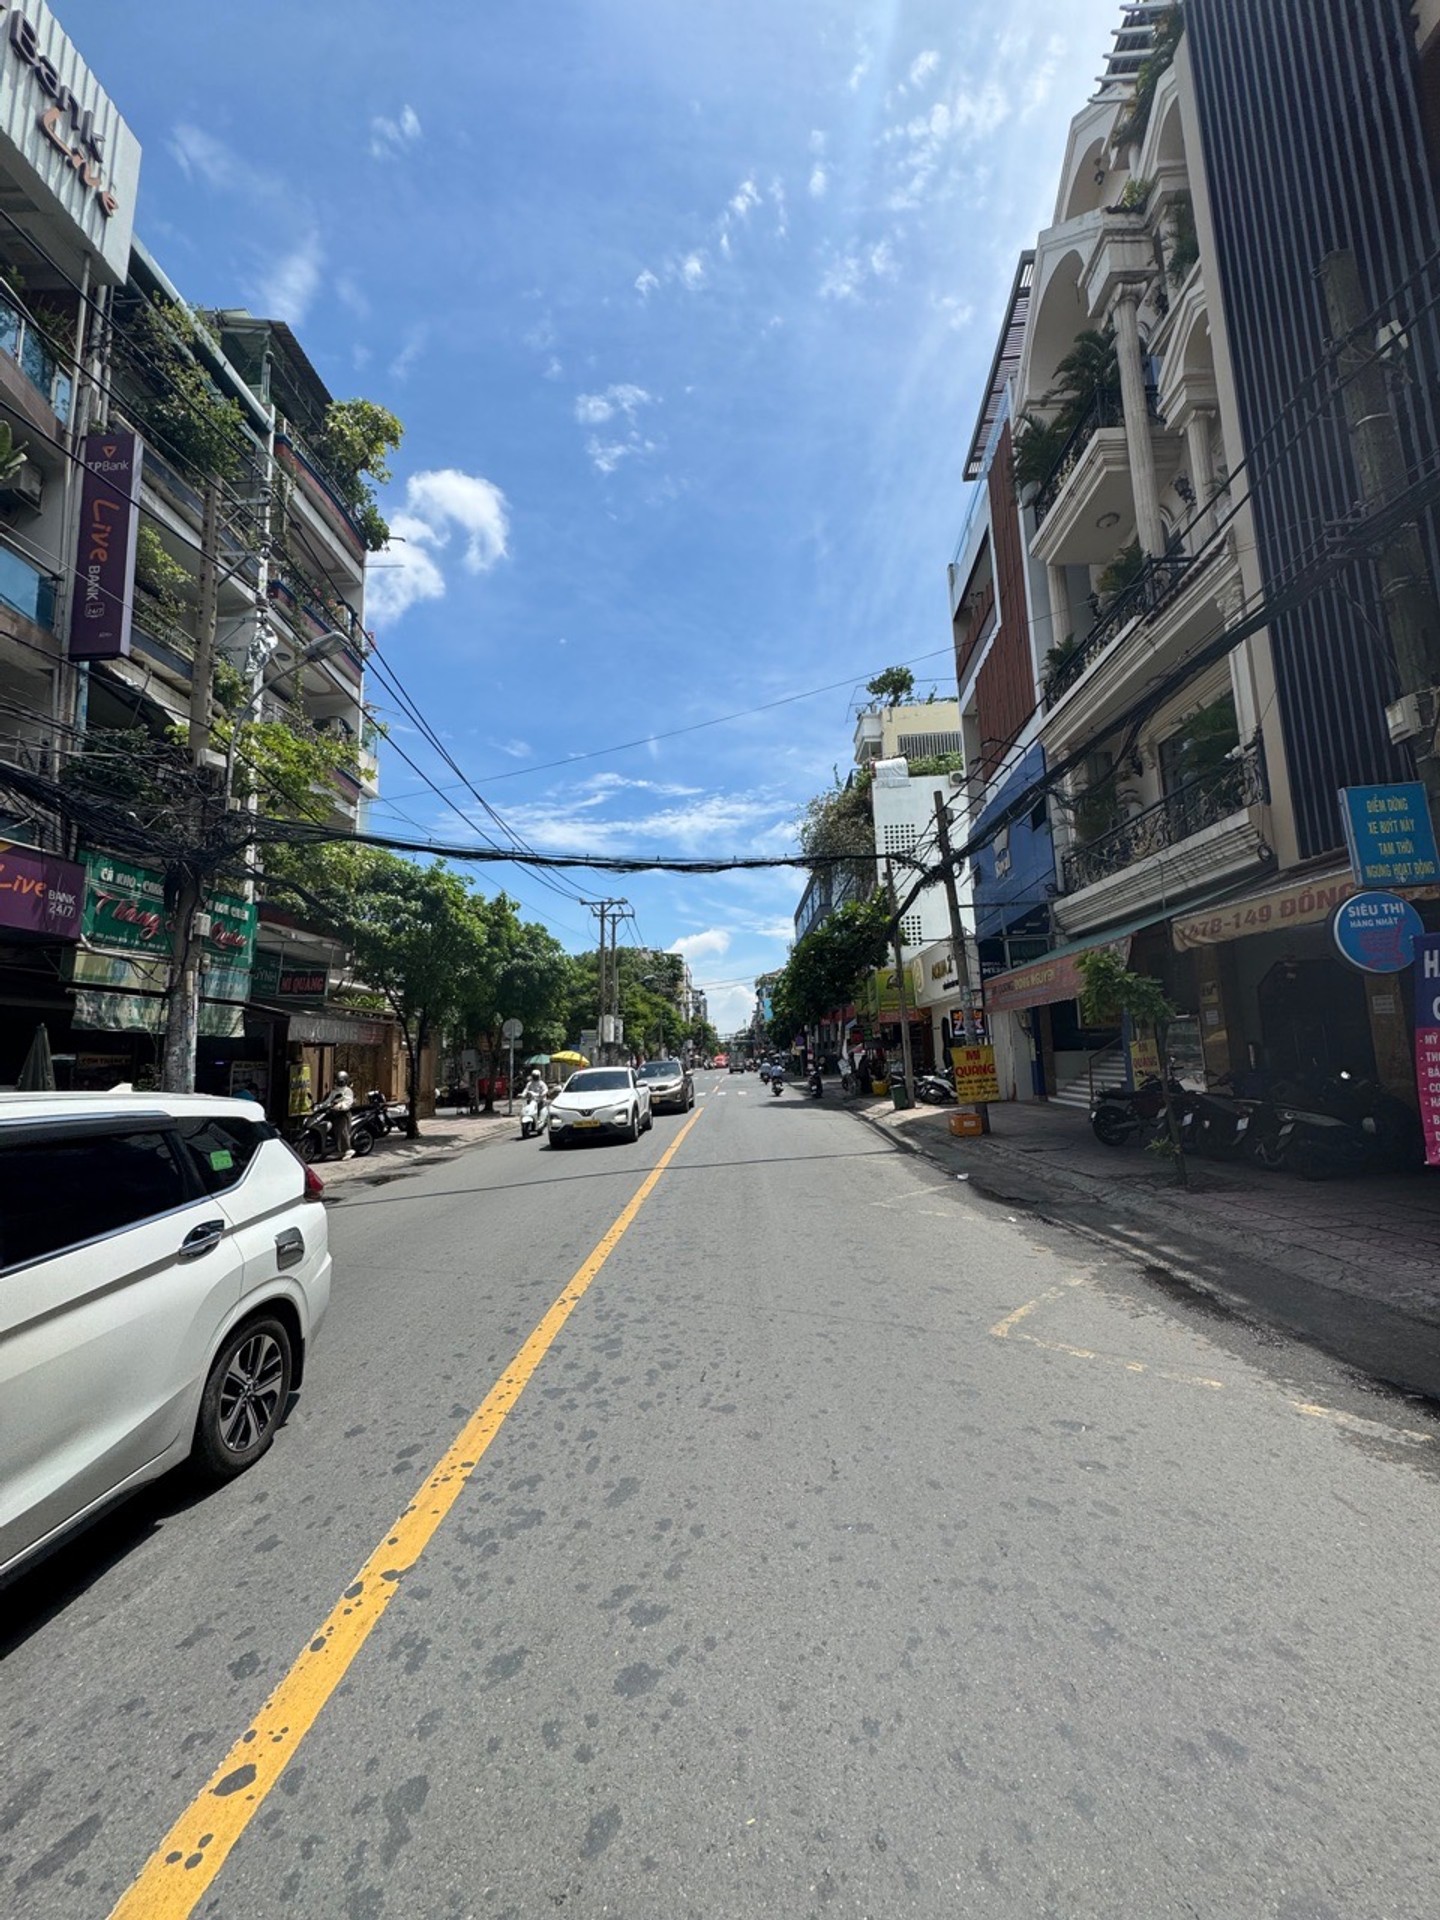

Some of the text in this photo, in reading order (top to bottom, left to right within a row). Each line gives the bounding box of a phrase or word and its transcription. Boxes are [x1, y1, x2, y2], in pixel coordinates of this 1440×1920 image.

[89, 498, 120, 563] Live
[86, 565, 101, 601] BANK
[48, 889, 76, 905] BANK
[49, 903, 73, 917] 24/7
[1347, 902, 1379, 918] SIÊU
[1424, 949, 1440, 979] H
[1425, 1051, 1440, 1062] TH
